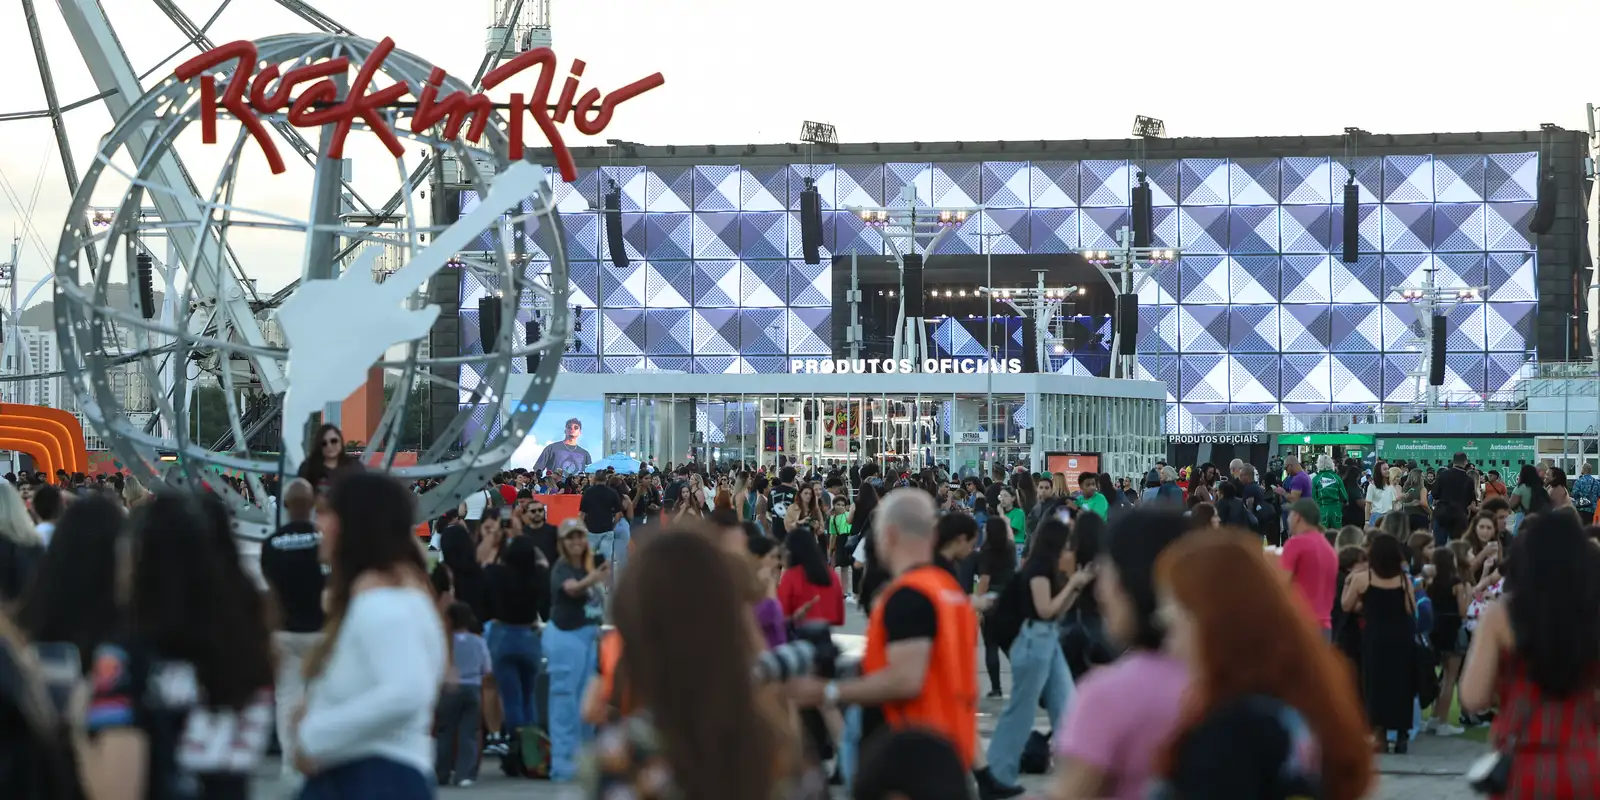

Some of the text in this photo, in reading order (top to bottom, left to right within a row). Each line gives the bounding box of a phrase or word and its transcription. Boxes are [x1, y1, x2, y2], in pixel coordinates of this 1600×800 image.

[175, 36, 665, 182] Rock in Rio
[792, 358, 1022, 374] PRODUTOS OFICIAIS
[1169, 434, 1258, 443] PRODUTOS OFICIAIS
